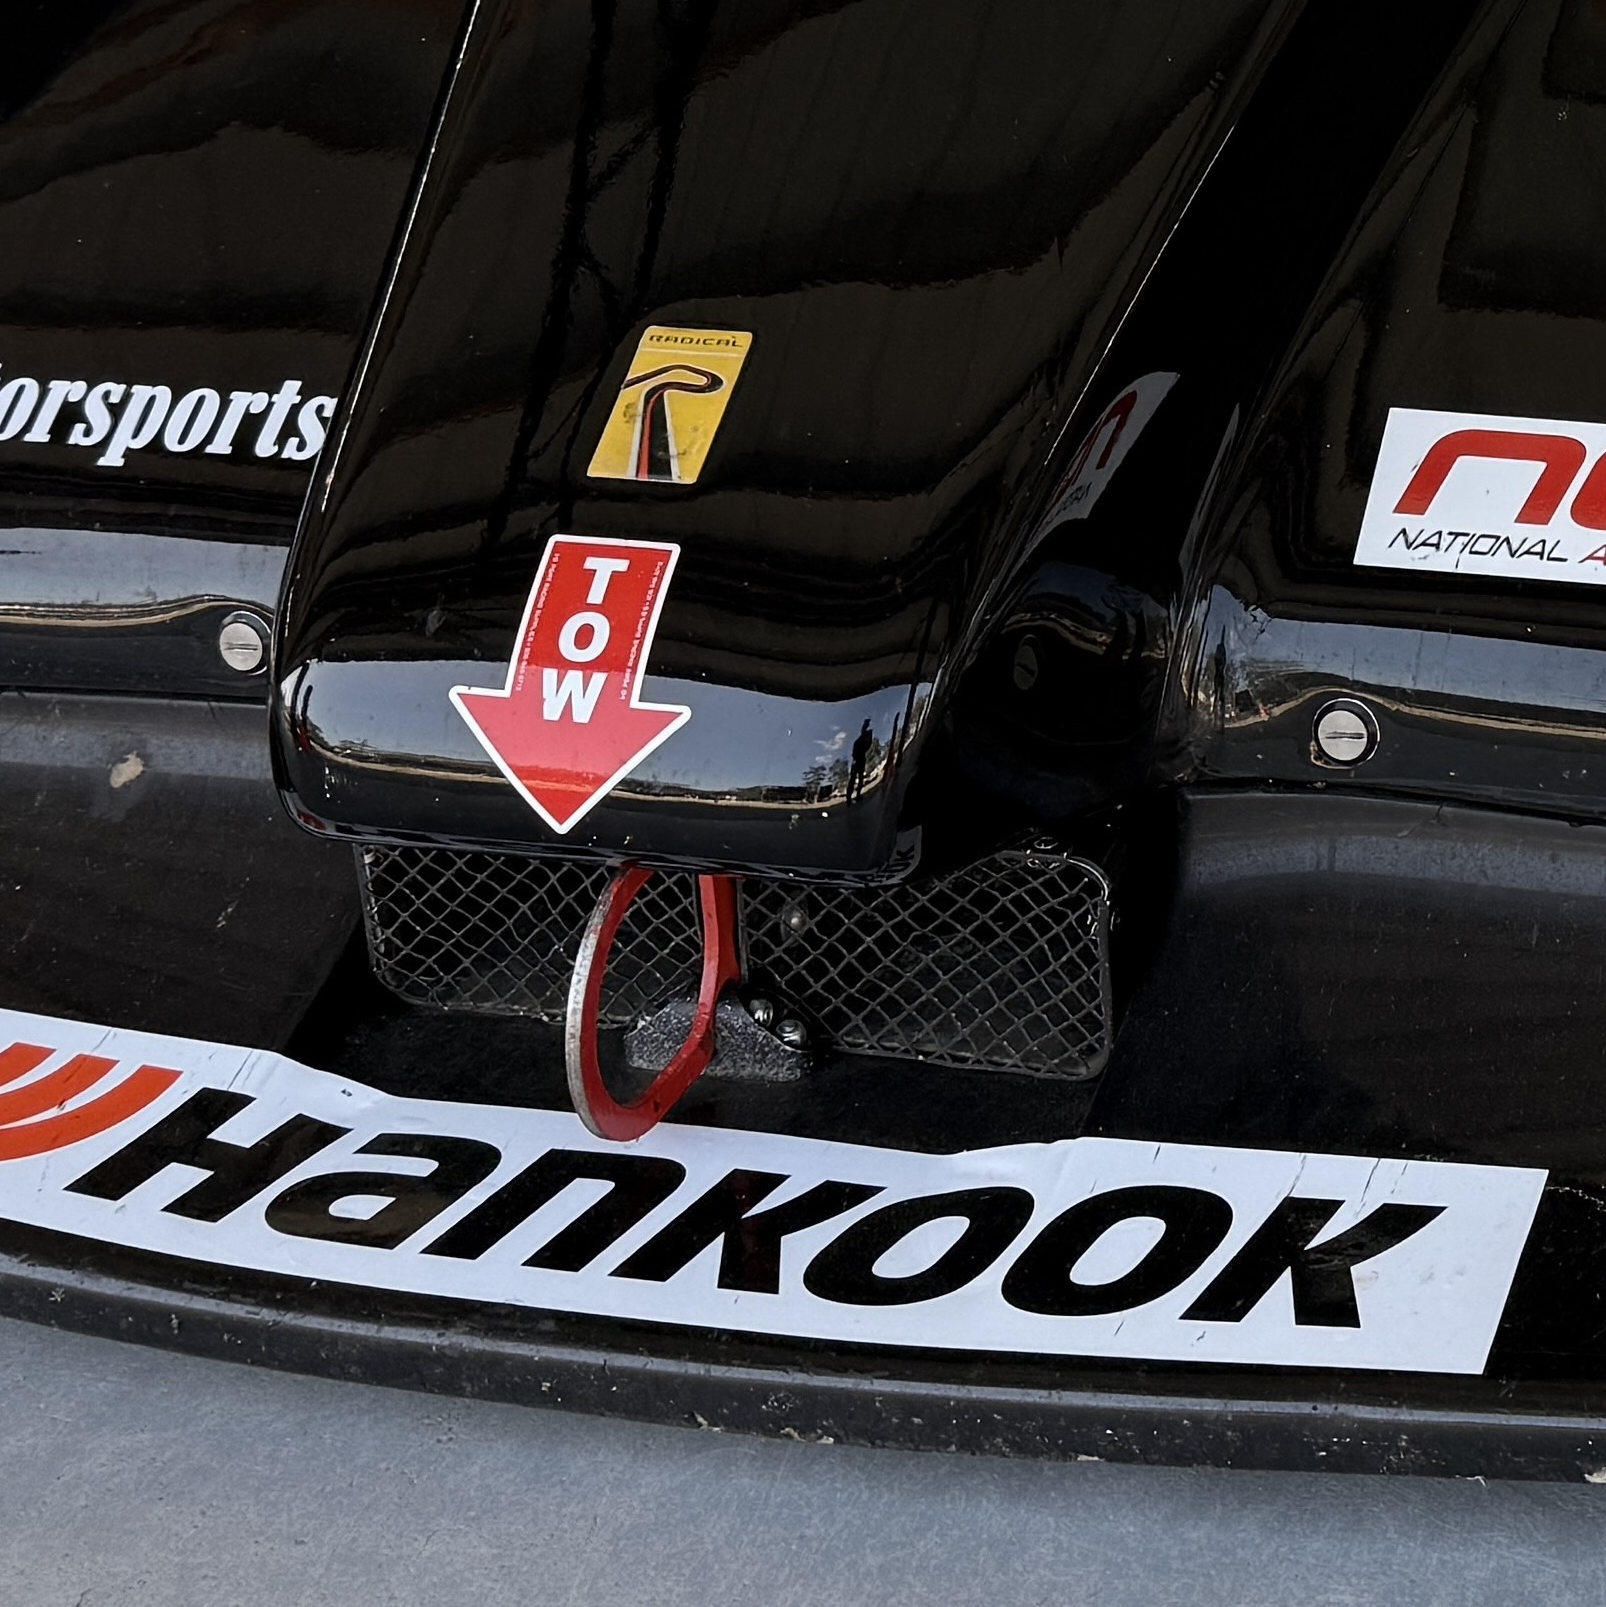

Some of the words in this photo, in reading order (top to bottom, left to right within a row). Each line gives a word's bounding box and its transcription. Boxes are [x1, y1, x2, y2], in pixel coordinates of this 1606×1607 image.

[649, 334, 744, 348] RADICAL
[0, 376, 338, 467] orsports
[1388, 527, 1568, 564] NATIONAL
[543, 556, 631, 724] TOW
[62, 1087, 1448, 1329] Hankook
